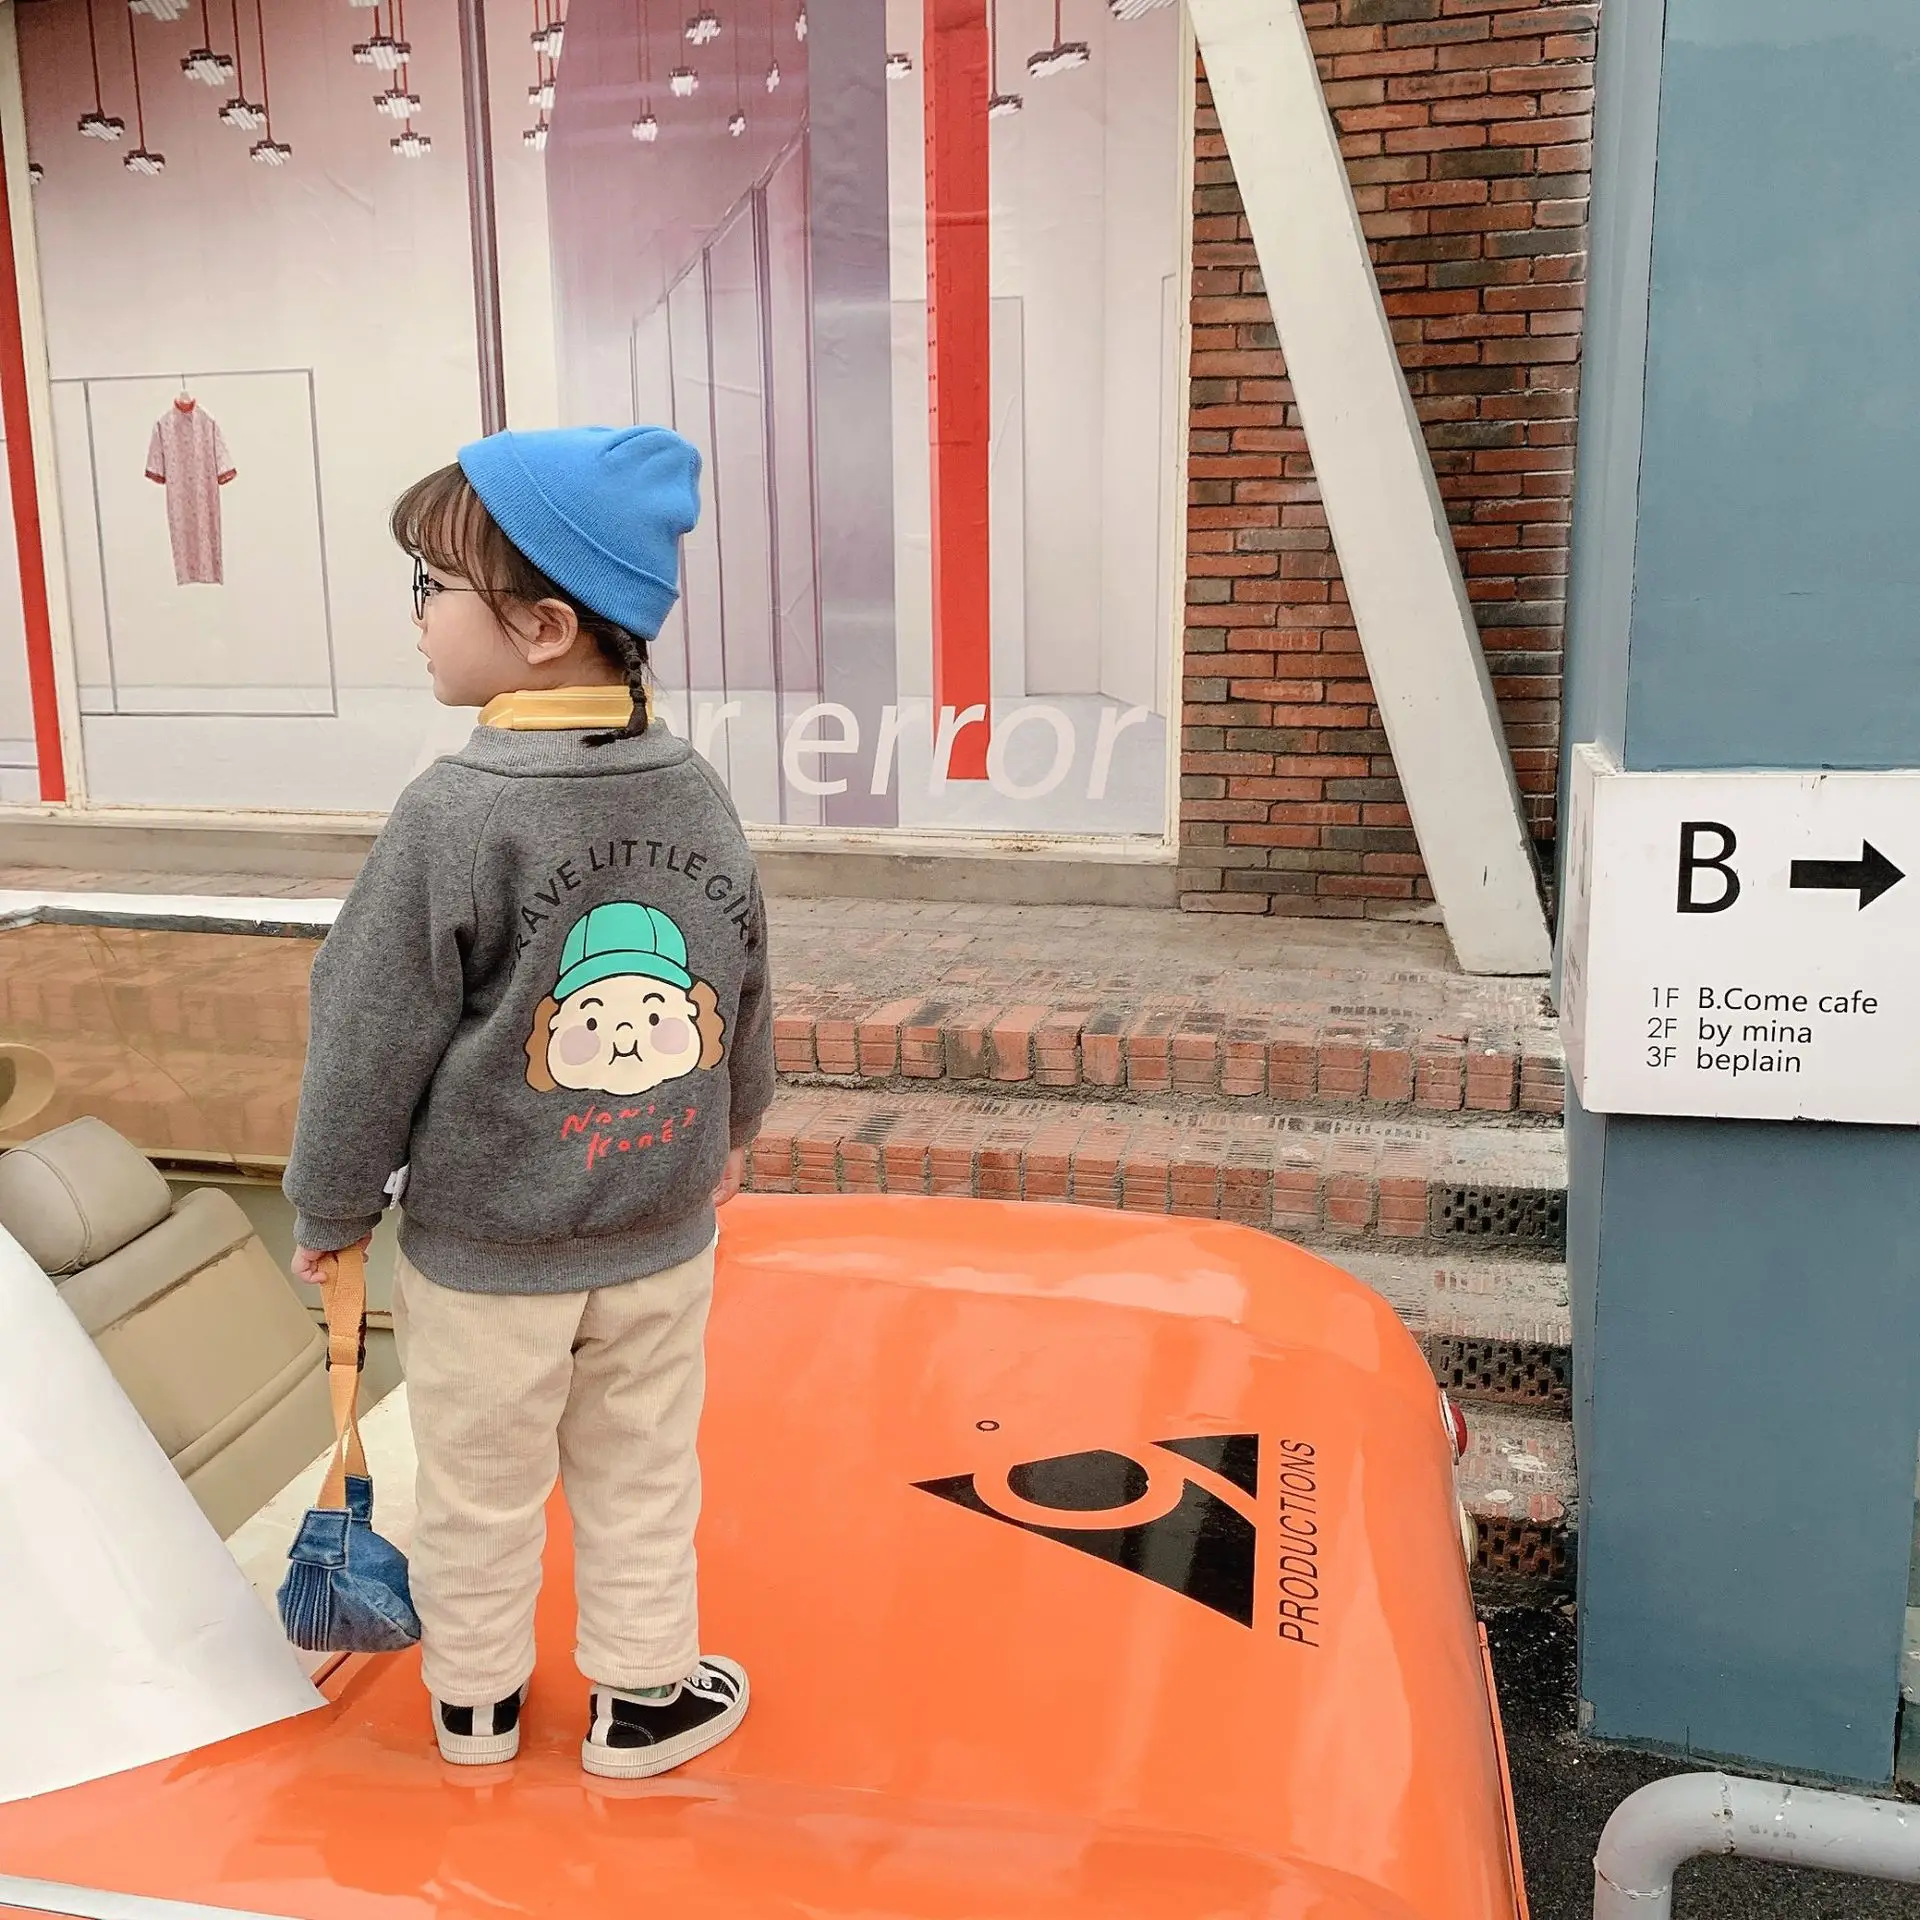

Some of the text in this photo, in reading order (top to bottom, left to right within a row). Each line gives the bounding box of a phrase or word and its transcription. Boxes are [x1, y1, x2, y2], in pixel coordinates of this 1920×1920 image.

[782, 700, 1150, 802] error
[588, 840, 707, 881] LITTLE
[1677, 822, 1741, 914] B
[1651, 987, 1879, 1015] 1F B.Come cafe
[1647, 1017, 1813, 1047] 2F by mina
[1646, 1046, 1802, 1077] 3F beplain
[1278, 1438, 1320, 1648] PRODUCTIONS
